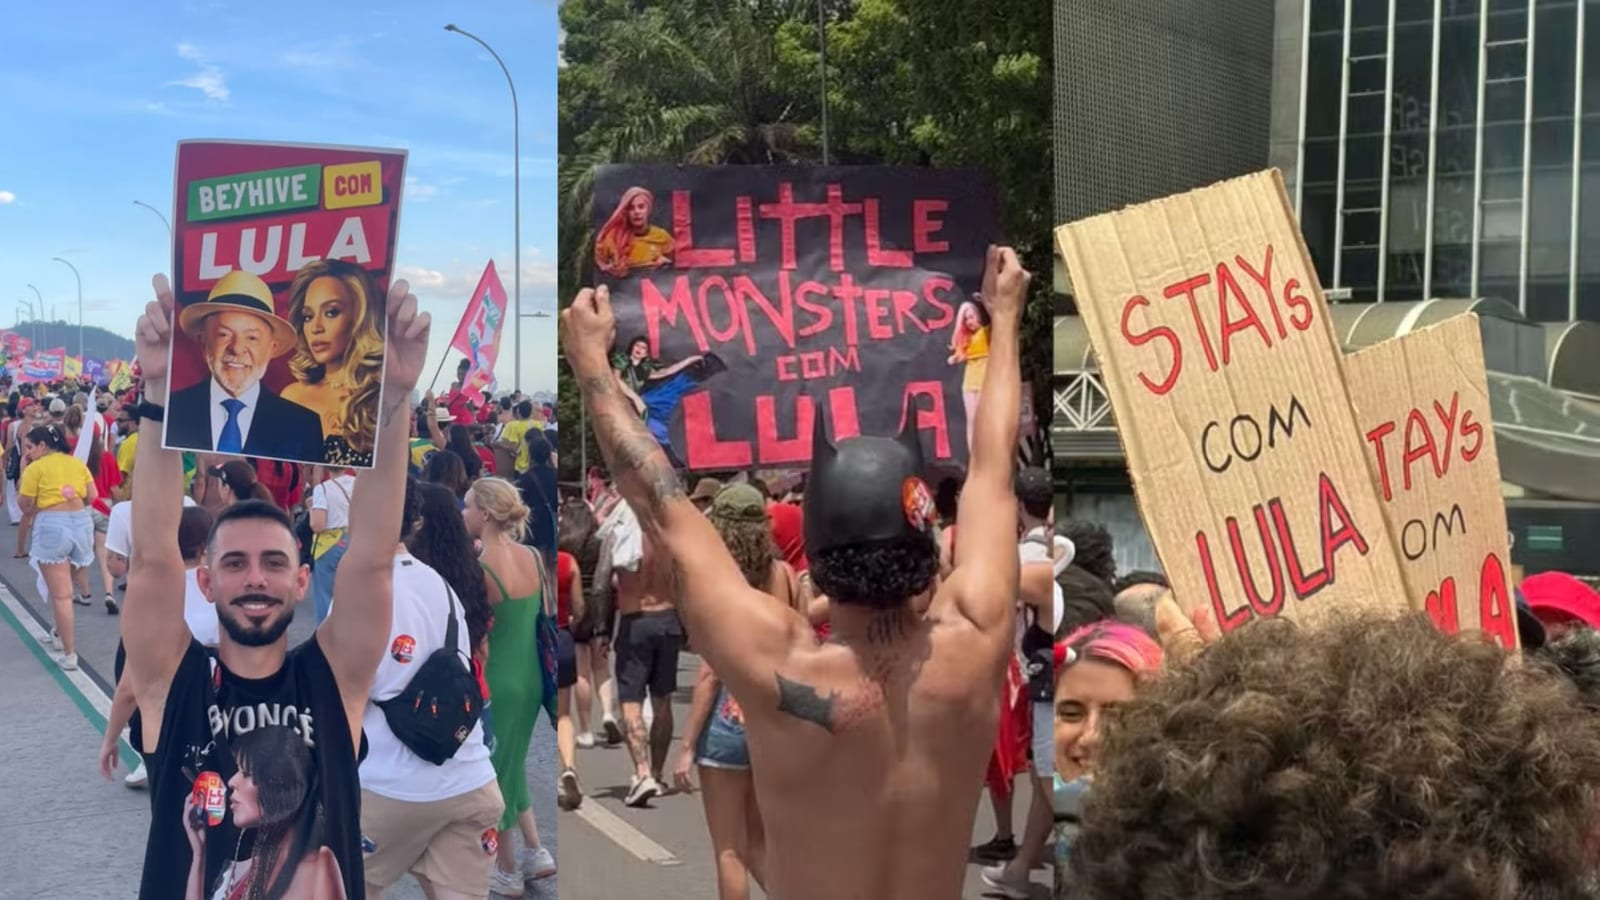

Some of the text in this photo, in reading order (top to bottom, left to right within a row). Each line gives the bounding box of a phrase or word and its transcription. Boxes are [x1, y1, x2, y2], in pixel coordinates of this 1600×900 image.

[199, 173, 372, 214] BEYHIVE COM
[198, 216, 372, 281] LULA
[776, 345, 862, 381] COM
[1202, 394, 1312, 474] COM
[1195, 471, 1370, 632] LULA
[1401, 503, 1467, 561] OM
